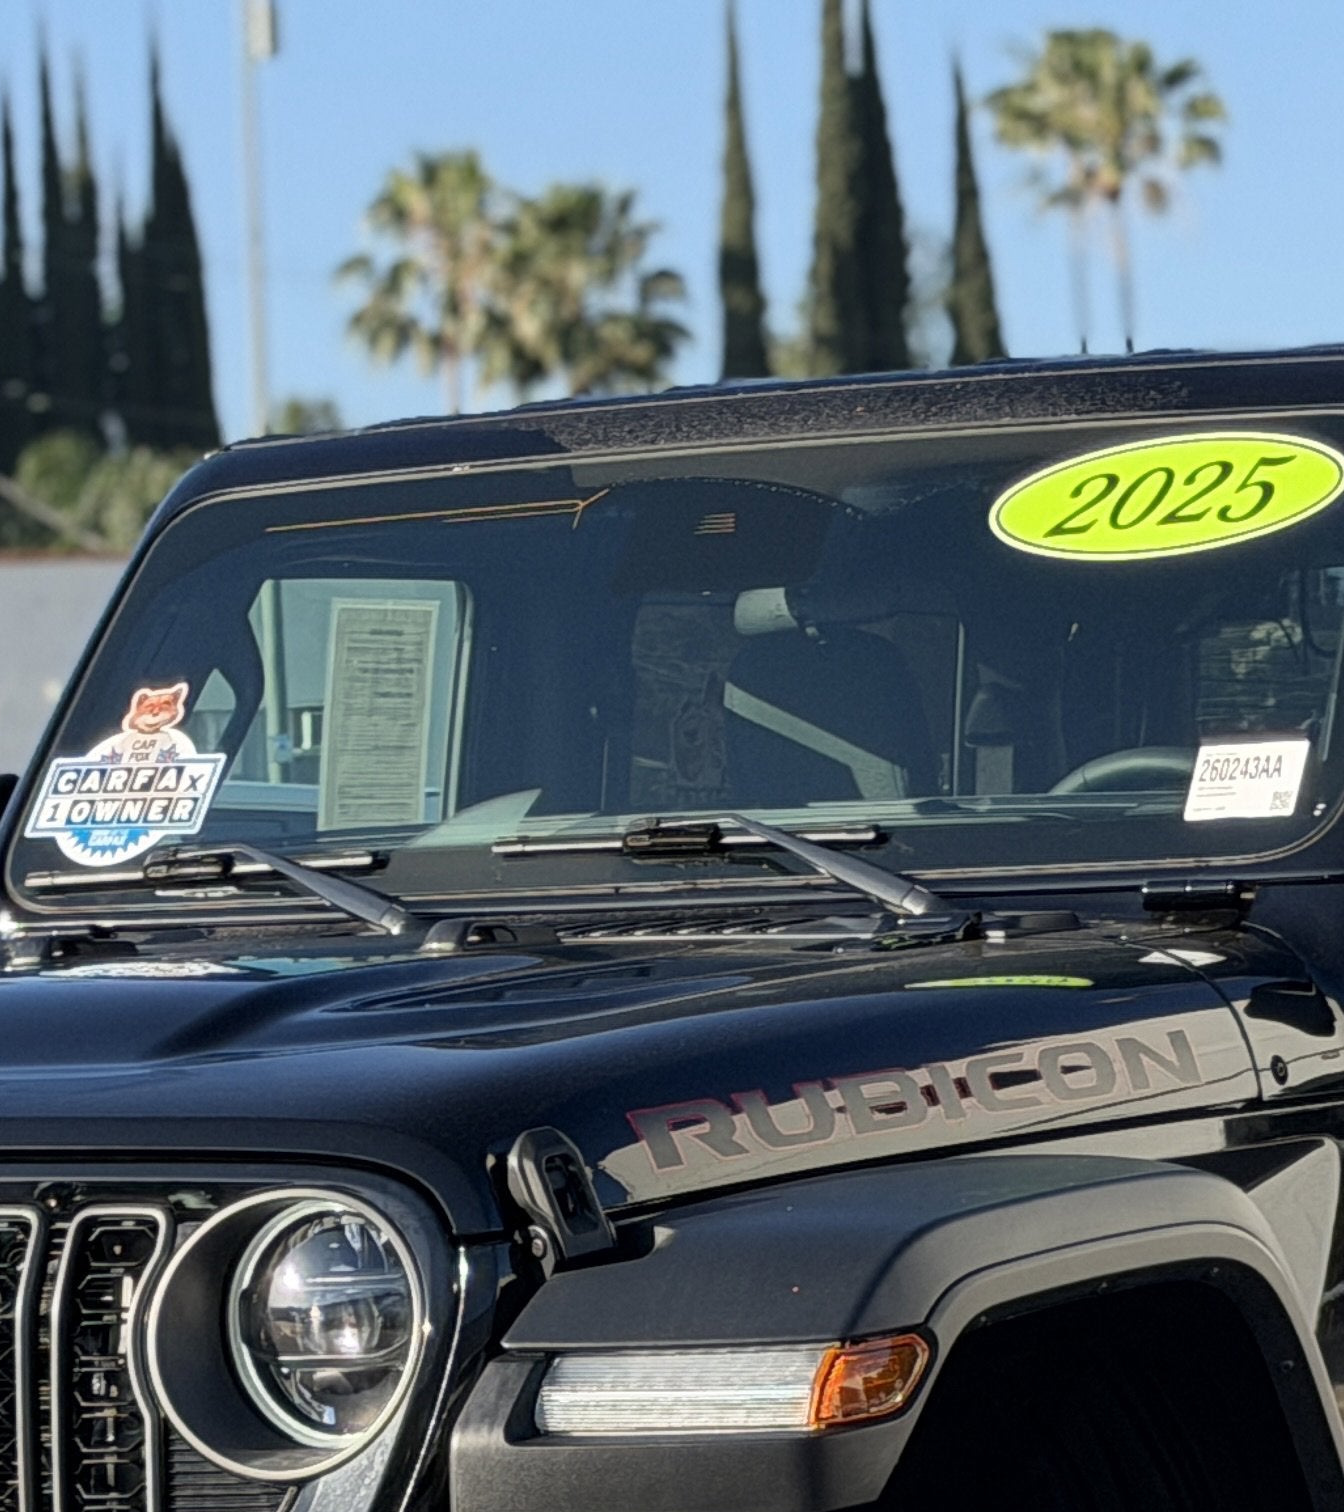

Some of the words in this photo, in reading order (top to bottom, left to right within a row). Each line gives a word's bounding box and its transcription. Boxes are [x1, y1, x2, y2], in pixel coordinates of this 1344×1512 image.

[1042, 454, 1297, 539] 2025
[128, 752, 150, 762] FOX
[131, 738, 157, 750] CAR
[54, 765, 206, 794] CARFAX
[1199, 754, 1283, 782] 260243AA
[44, 801, 60, 823] 1
[67, 799, 198, 825] OWNER
[626, 1028, 1202, 1174] RUBICON
